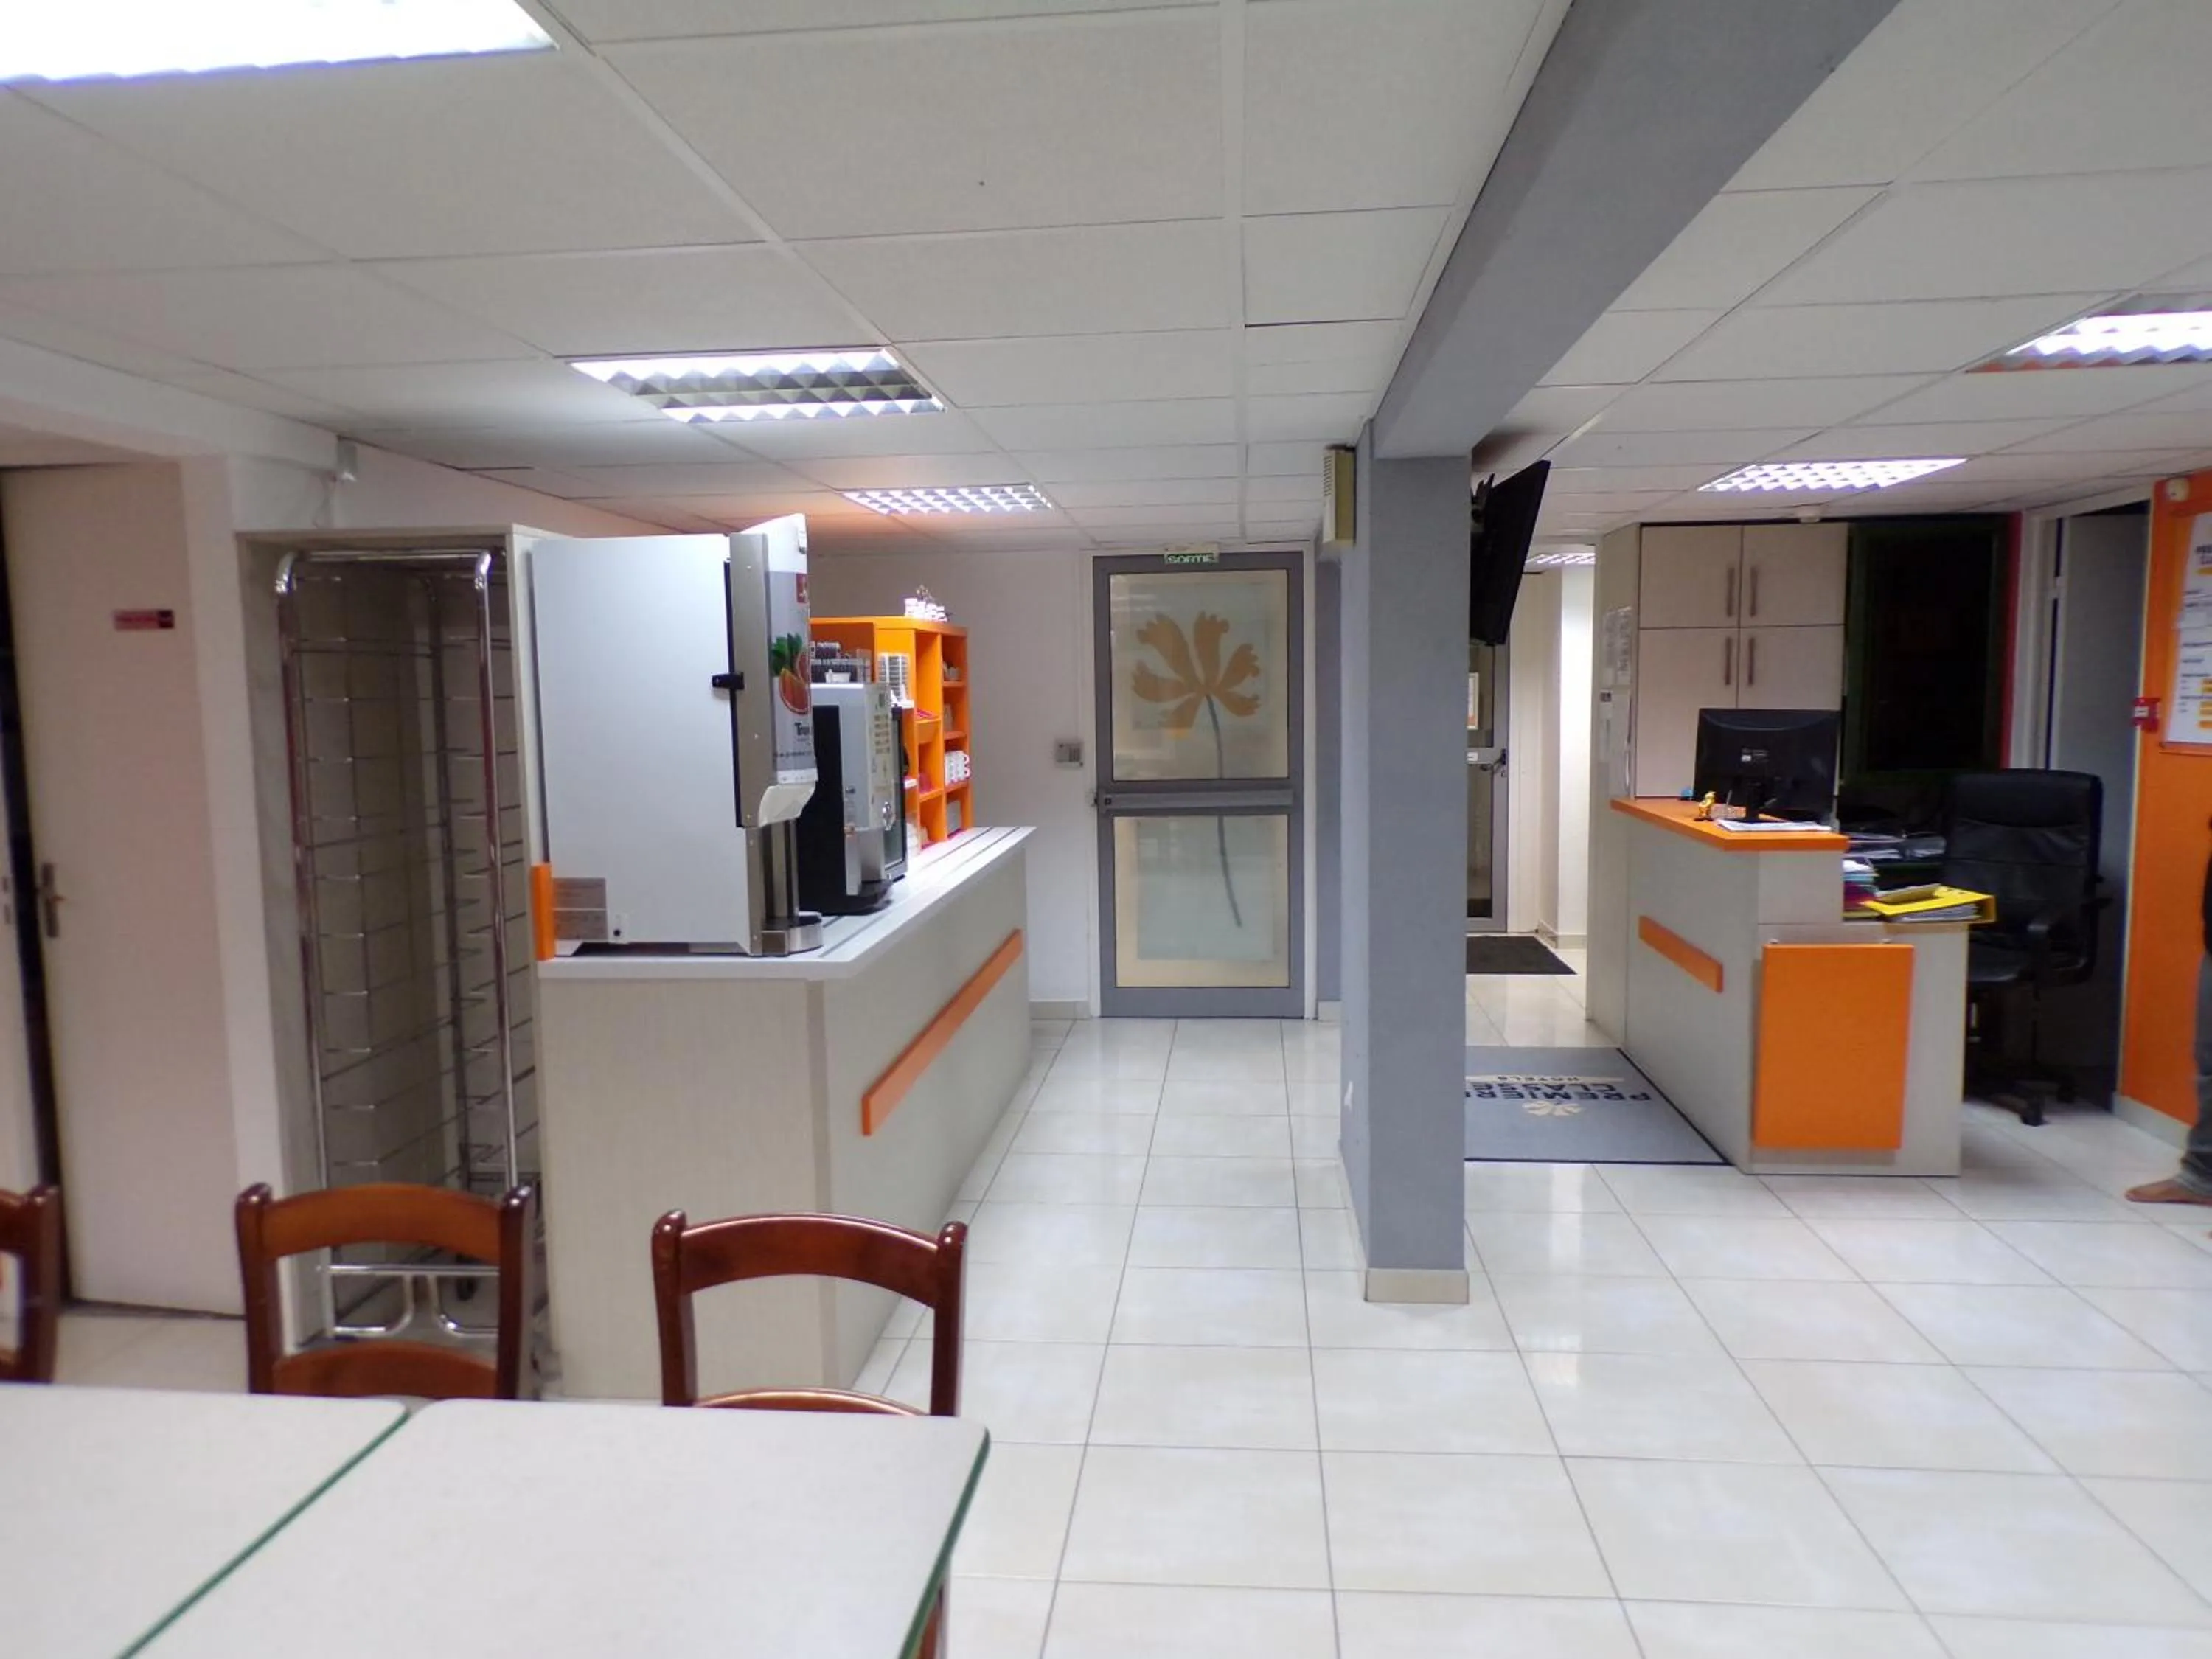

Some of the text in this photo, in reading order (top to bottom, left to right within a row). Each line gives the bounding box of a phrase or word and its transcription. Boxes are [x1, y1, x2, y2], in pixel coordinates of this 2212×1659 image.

[1167, 554, 1216, 565] SORTIE
[1472, 1083, 1616, 1092] CLASSE
[1465, 1091, 1652, 1101] PREMIER
